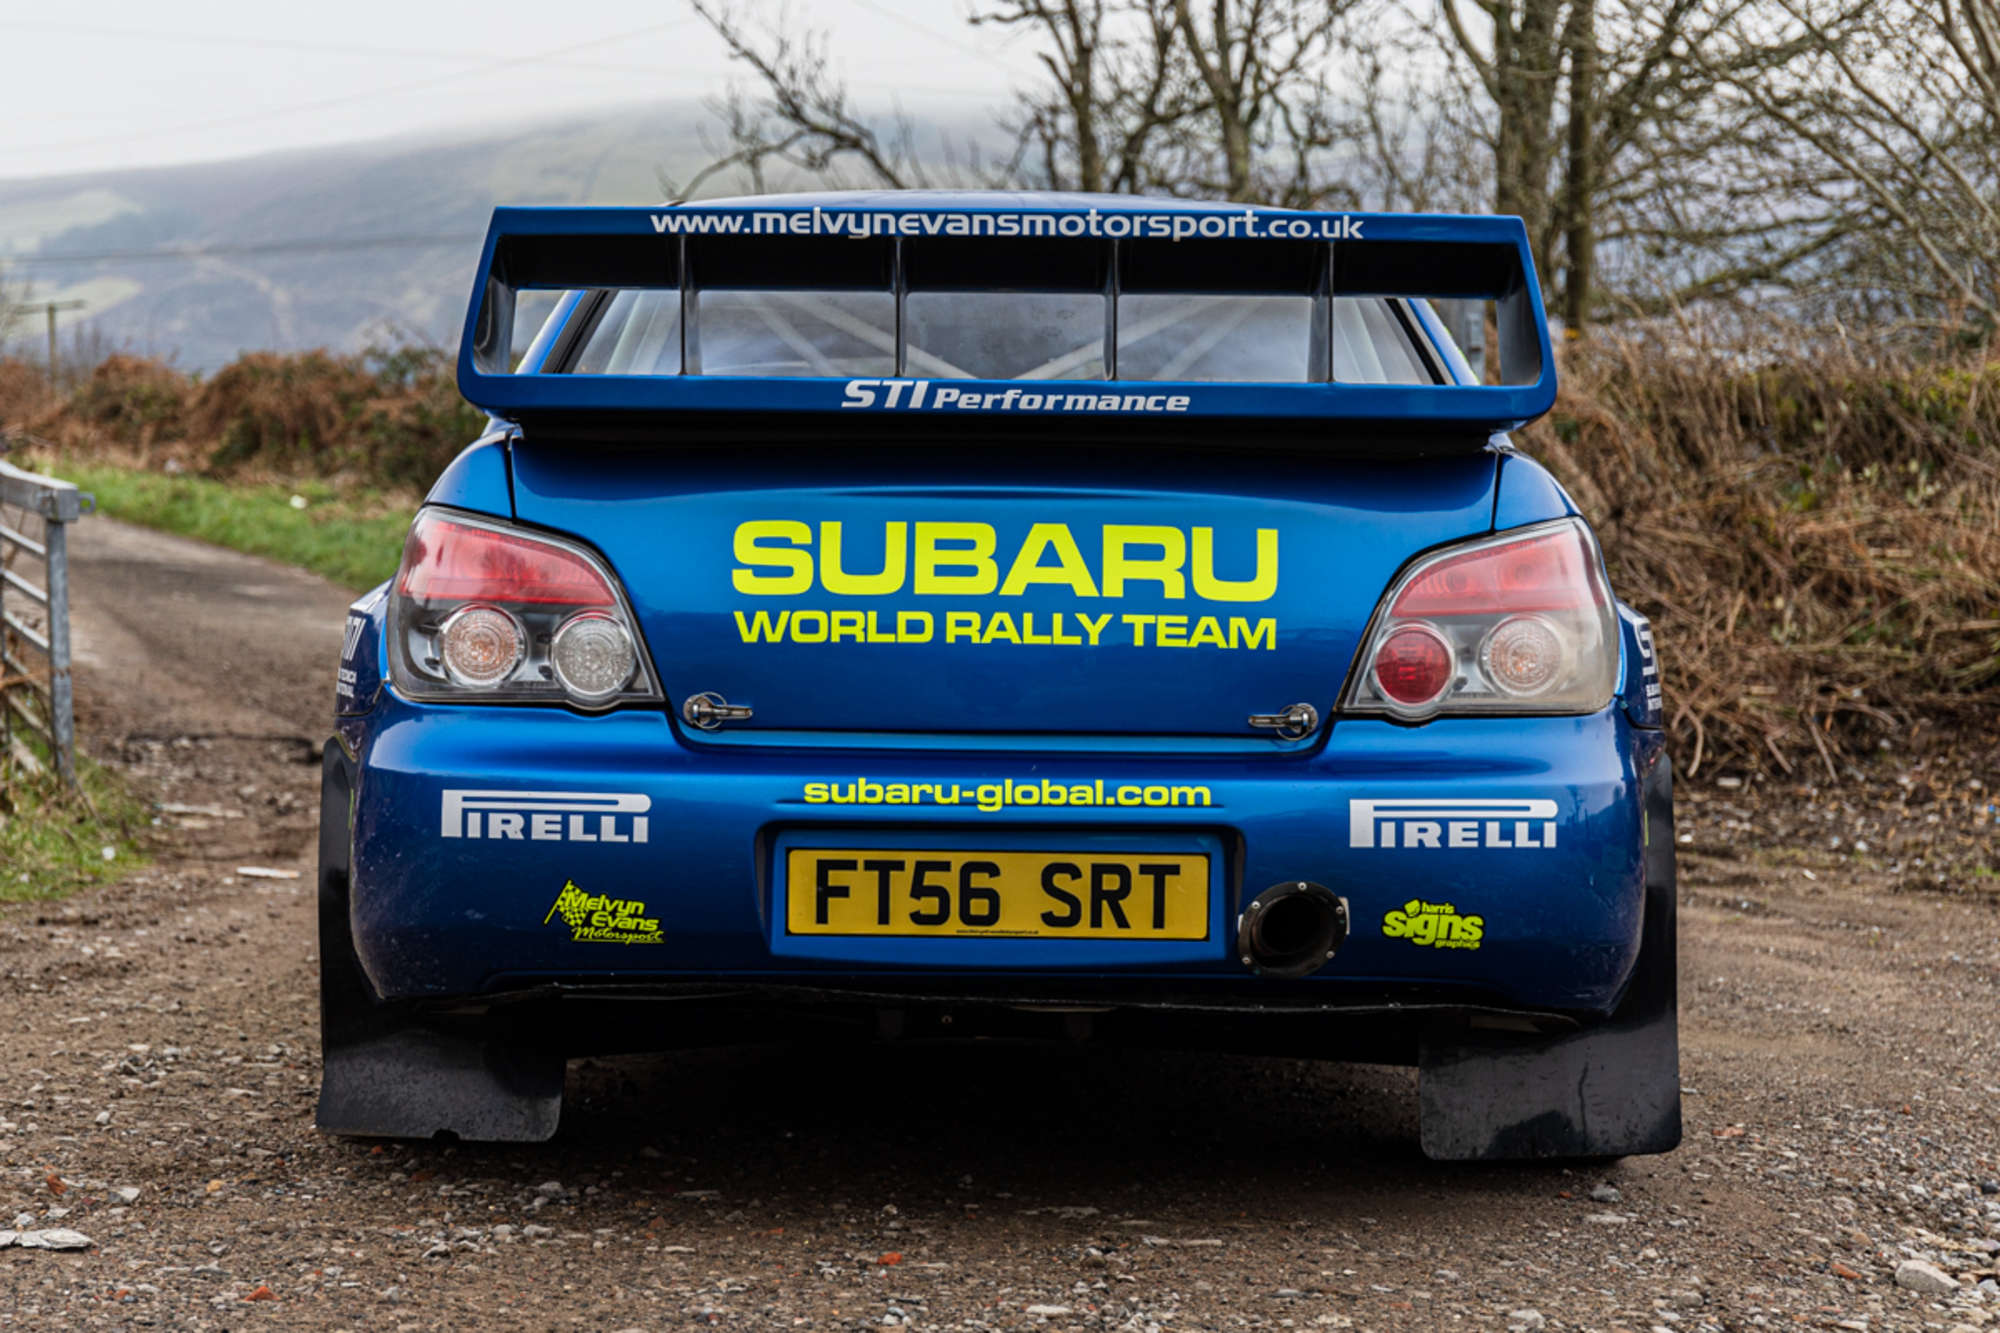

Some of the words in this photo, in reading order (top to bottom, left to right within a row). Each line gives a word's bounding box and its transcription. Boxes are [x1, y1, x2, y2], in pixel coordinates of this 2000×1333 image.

[650, 206, 1364, 242] www.melvynevansmotorsport.co.uk
[841, 380, 929, 409] STI
[933, 388, 1190, 412] Performance
[732, 520, 1279, 602] SUBARU
[733, 610, 934, 644] WORLD
[946, 612, 1114, 646] RALLY
[1122, 615, 1277, 651] TEAM
[803, 778, 1212, 812] subaru-global.com
[441, 789, 652, 843] PIRELLI
[1349, 799, 1559, 848] PIRELLI
[563, 892, 645, 917] Melvyn
[815, 858, 1001, 927] FT56
[1040, 862, 1181, 930] SRT
[571, 926, 664, 944] Motorsport
[591, 911, 659, 931] Evans
